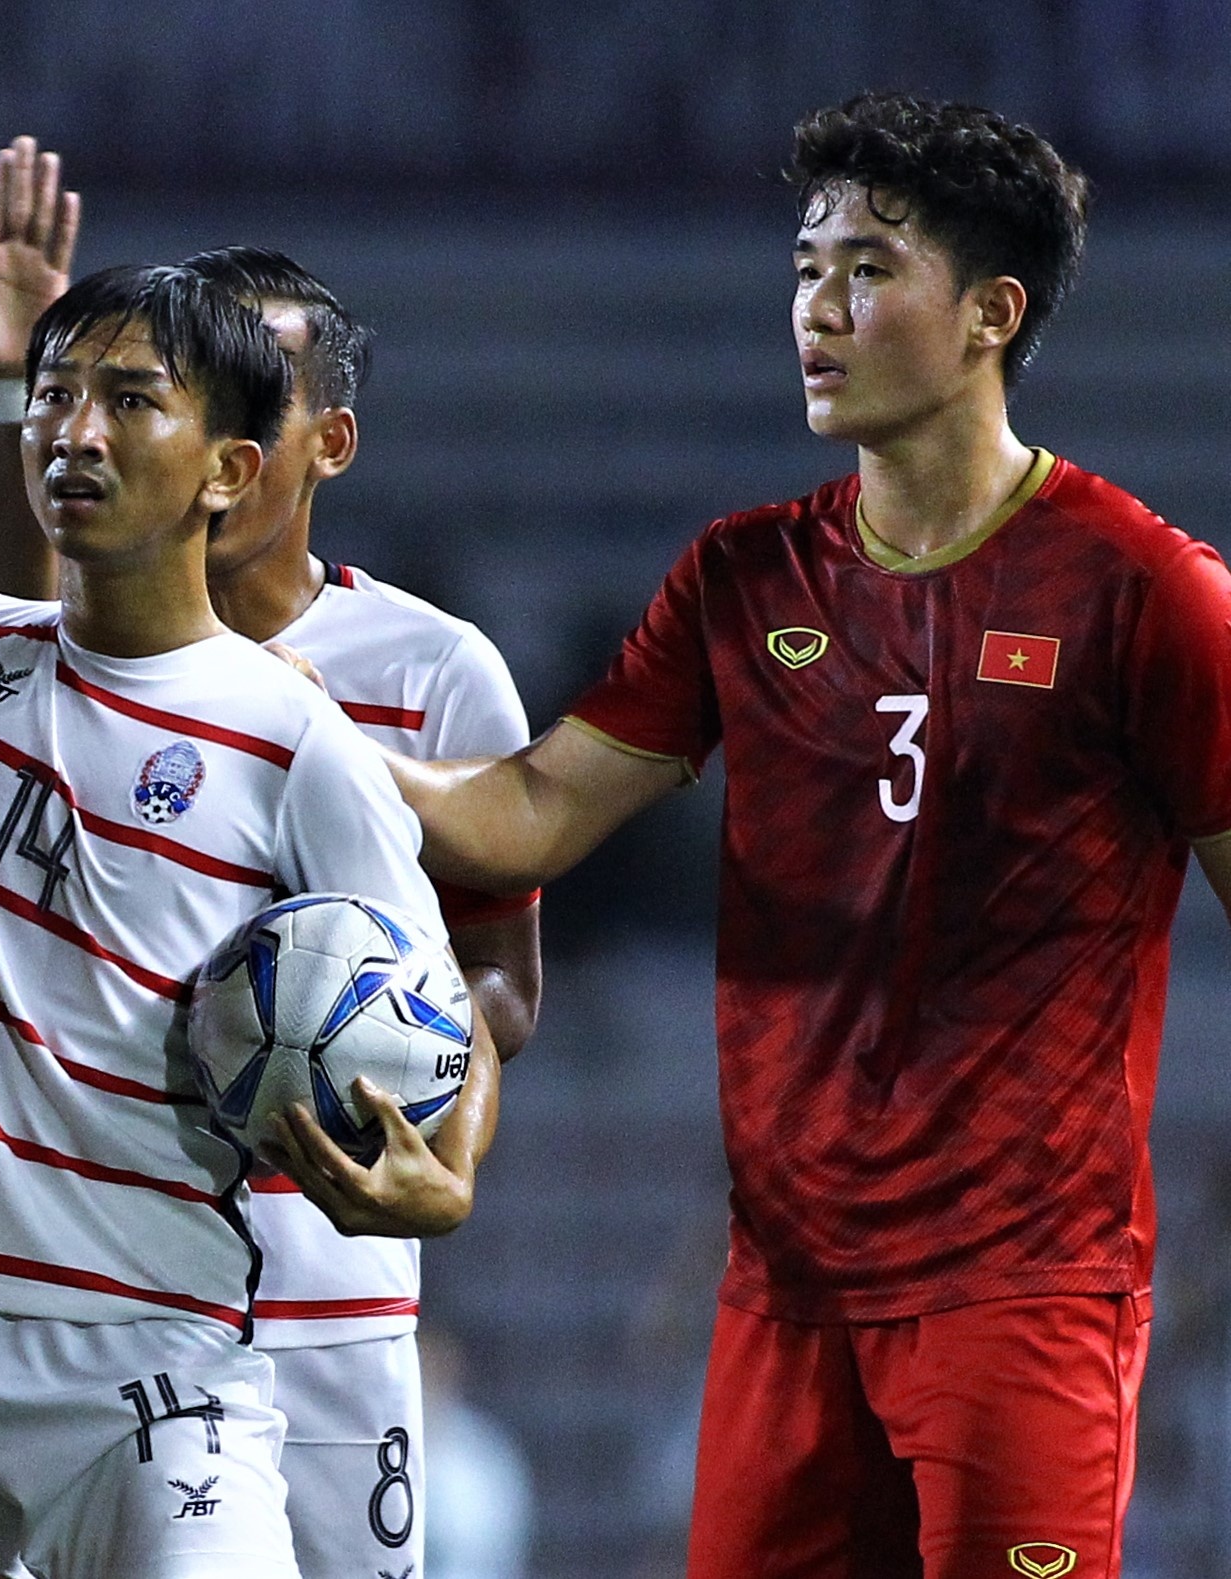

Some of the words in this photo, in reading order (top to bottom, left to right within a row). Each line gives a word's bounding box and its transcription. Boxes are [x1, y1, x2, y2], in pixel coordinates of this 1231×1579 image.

[875, 694, 929, 822] 3
[118, 1372, 224, 1463] 14
[173, 1499, 222, 1519] FBT
[369, 1426, 414, 1549] 8
